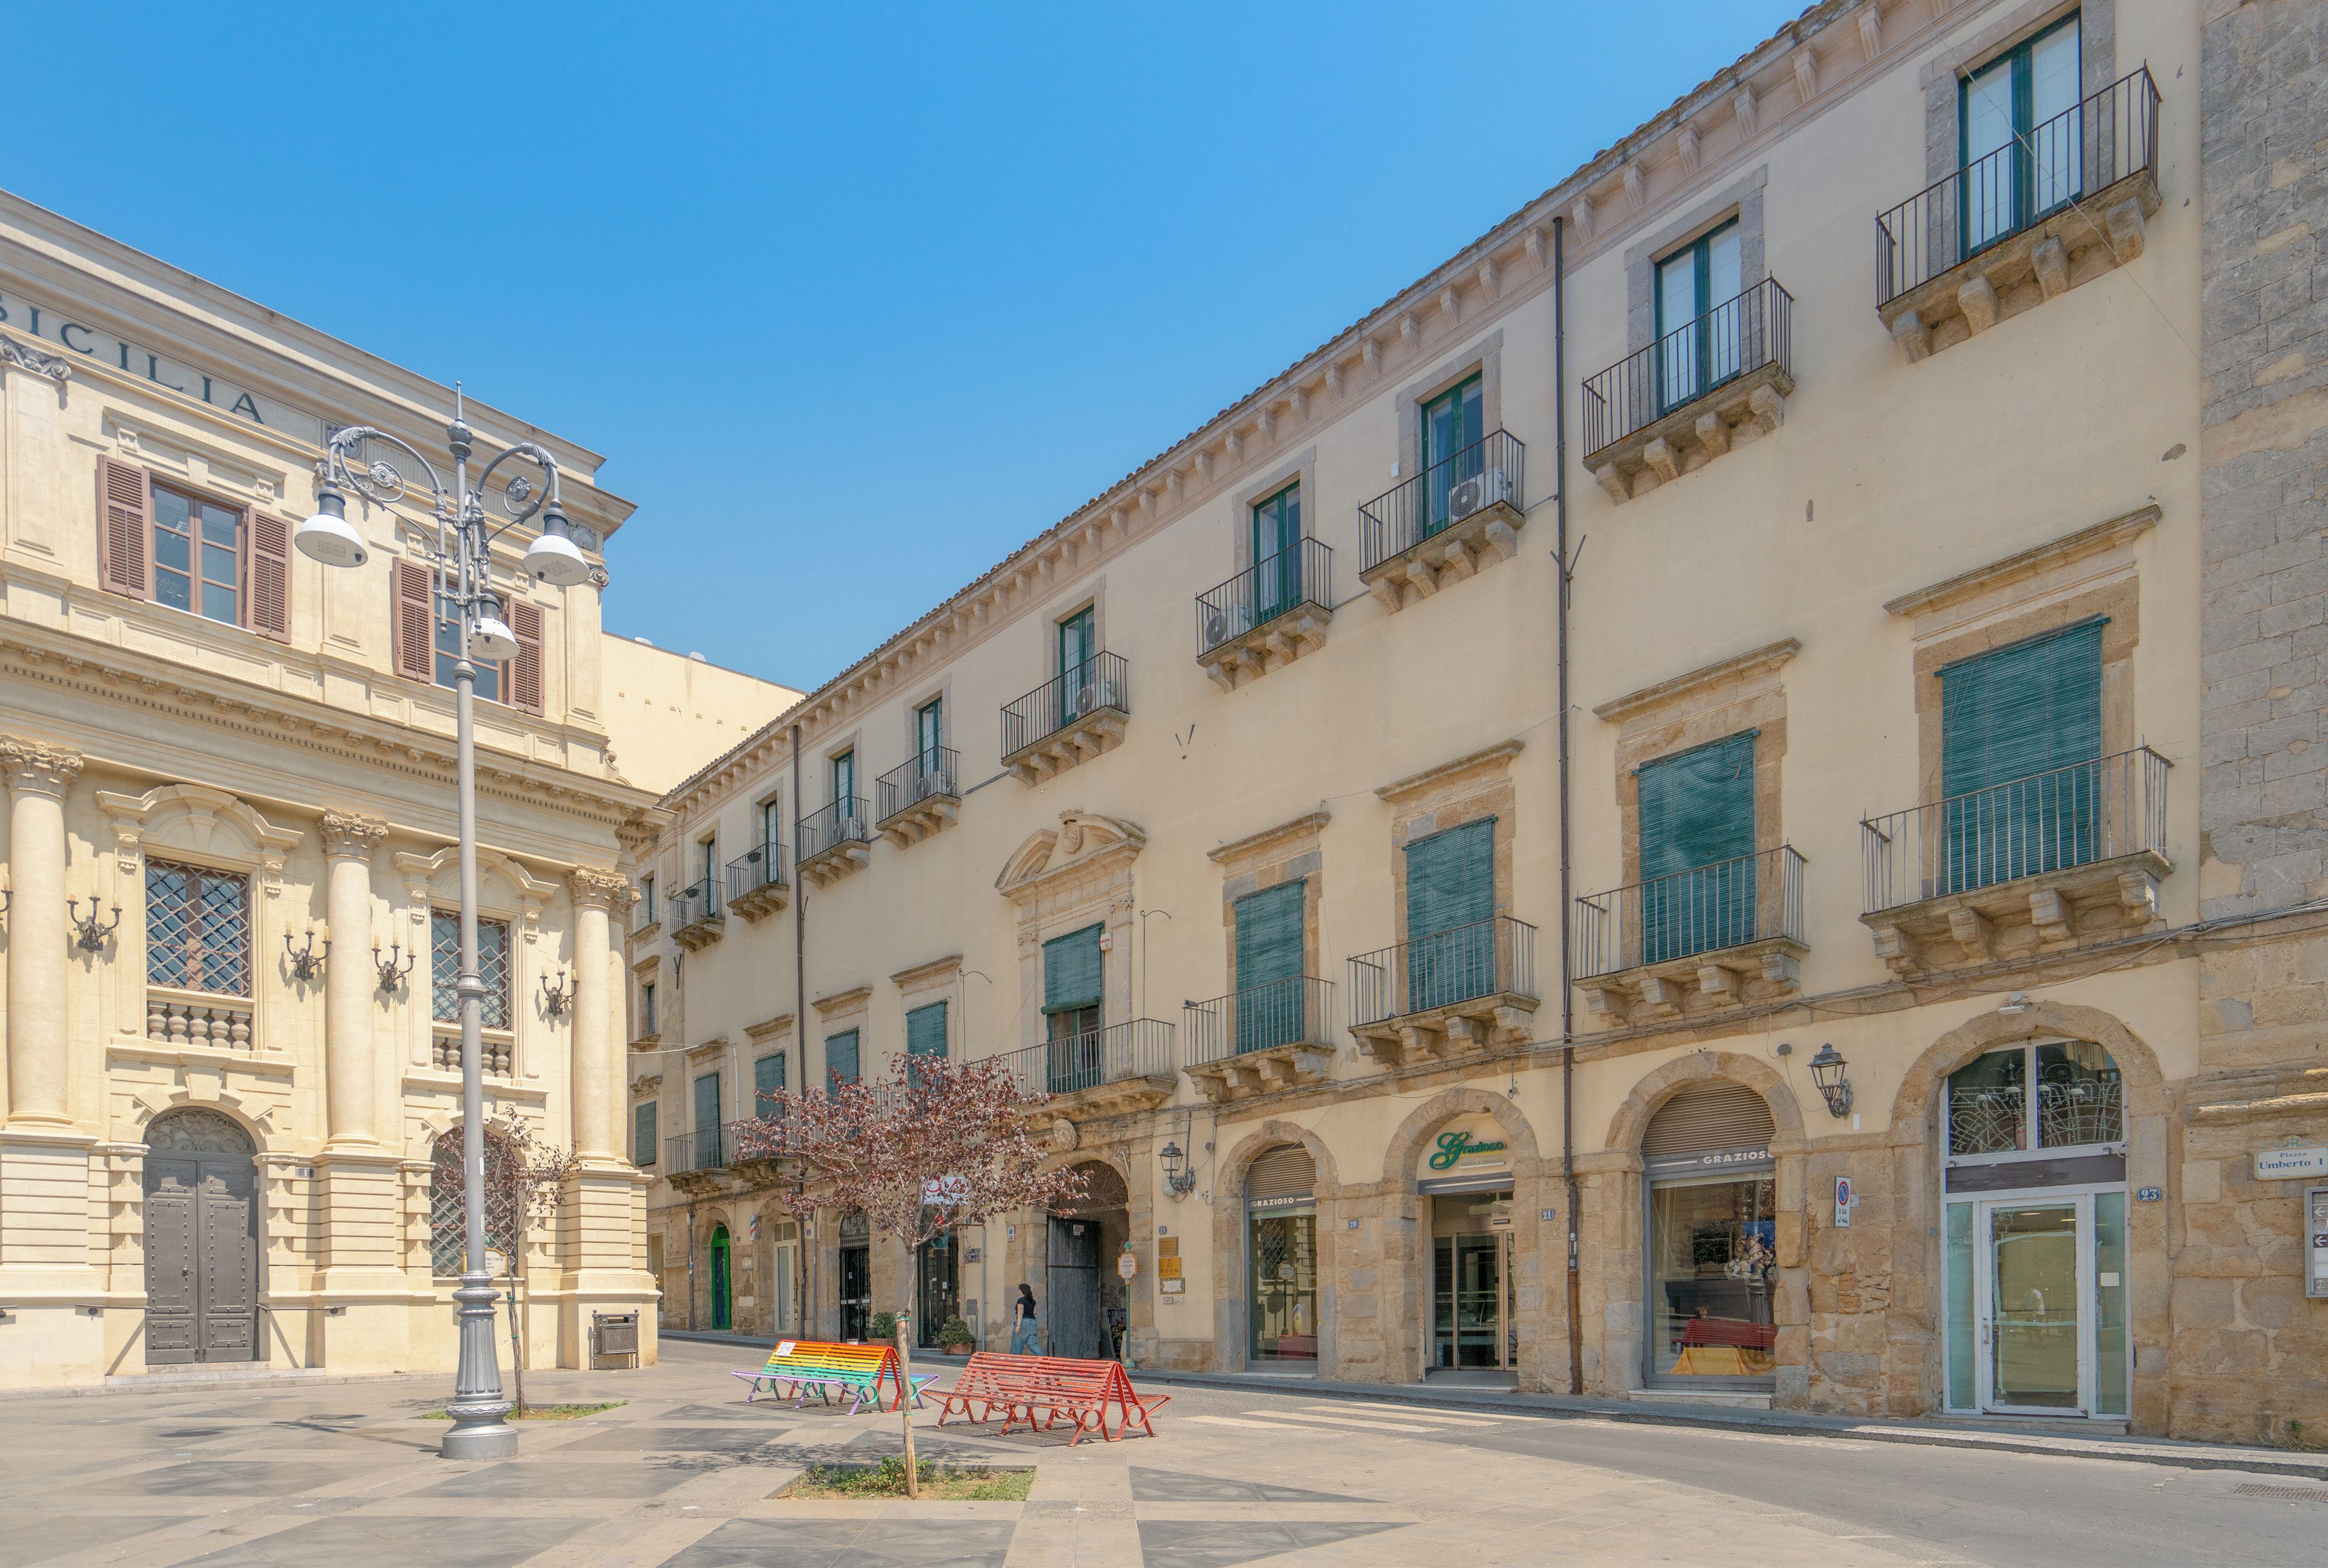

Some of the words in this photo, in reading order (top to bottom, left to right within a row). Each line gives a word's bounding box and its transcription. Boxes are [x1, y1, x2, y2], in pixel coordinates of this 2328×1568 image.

[1429, 1131, 1504, 1170] Grazioso
[2259, 1160, 2311, 1169] Umberto
[2141, 1189, 2156, 1199] 23
[1252, 1197, 1294, 1207] GRAZIOSO
[1542, 1210, 1551, 1219] 21
